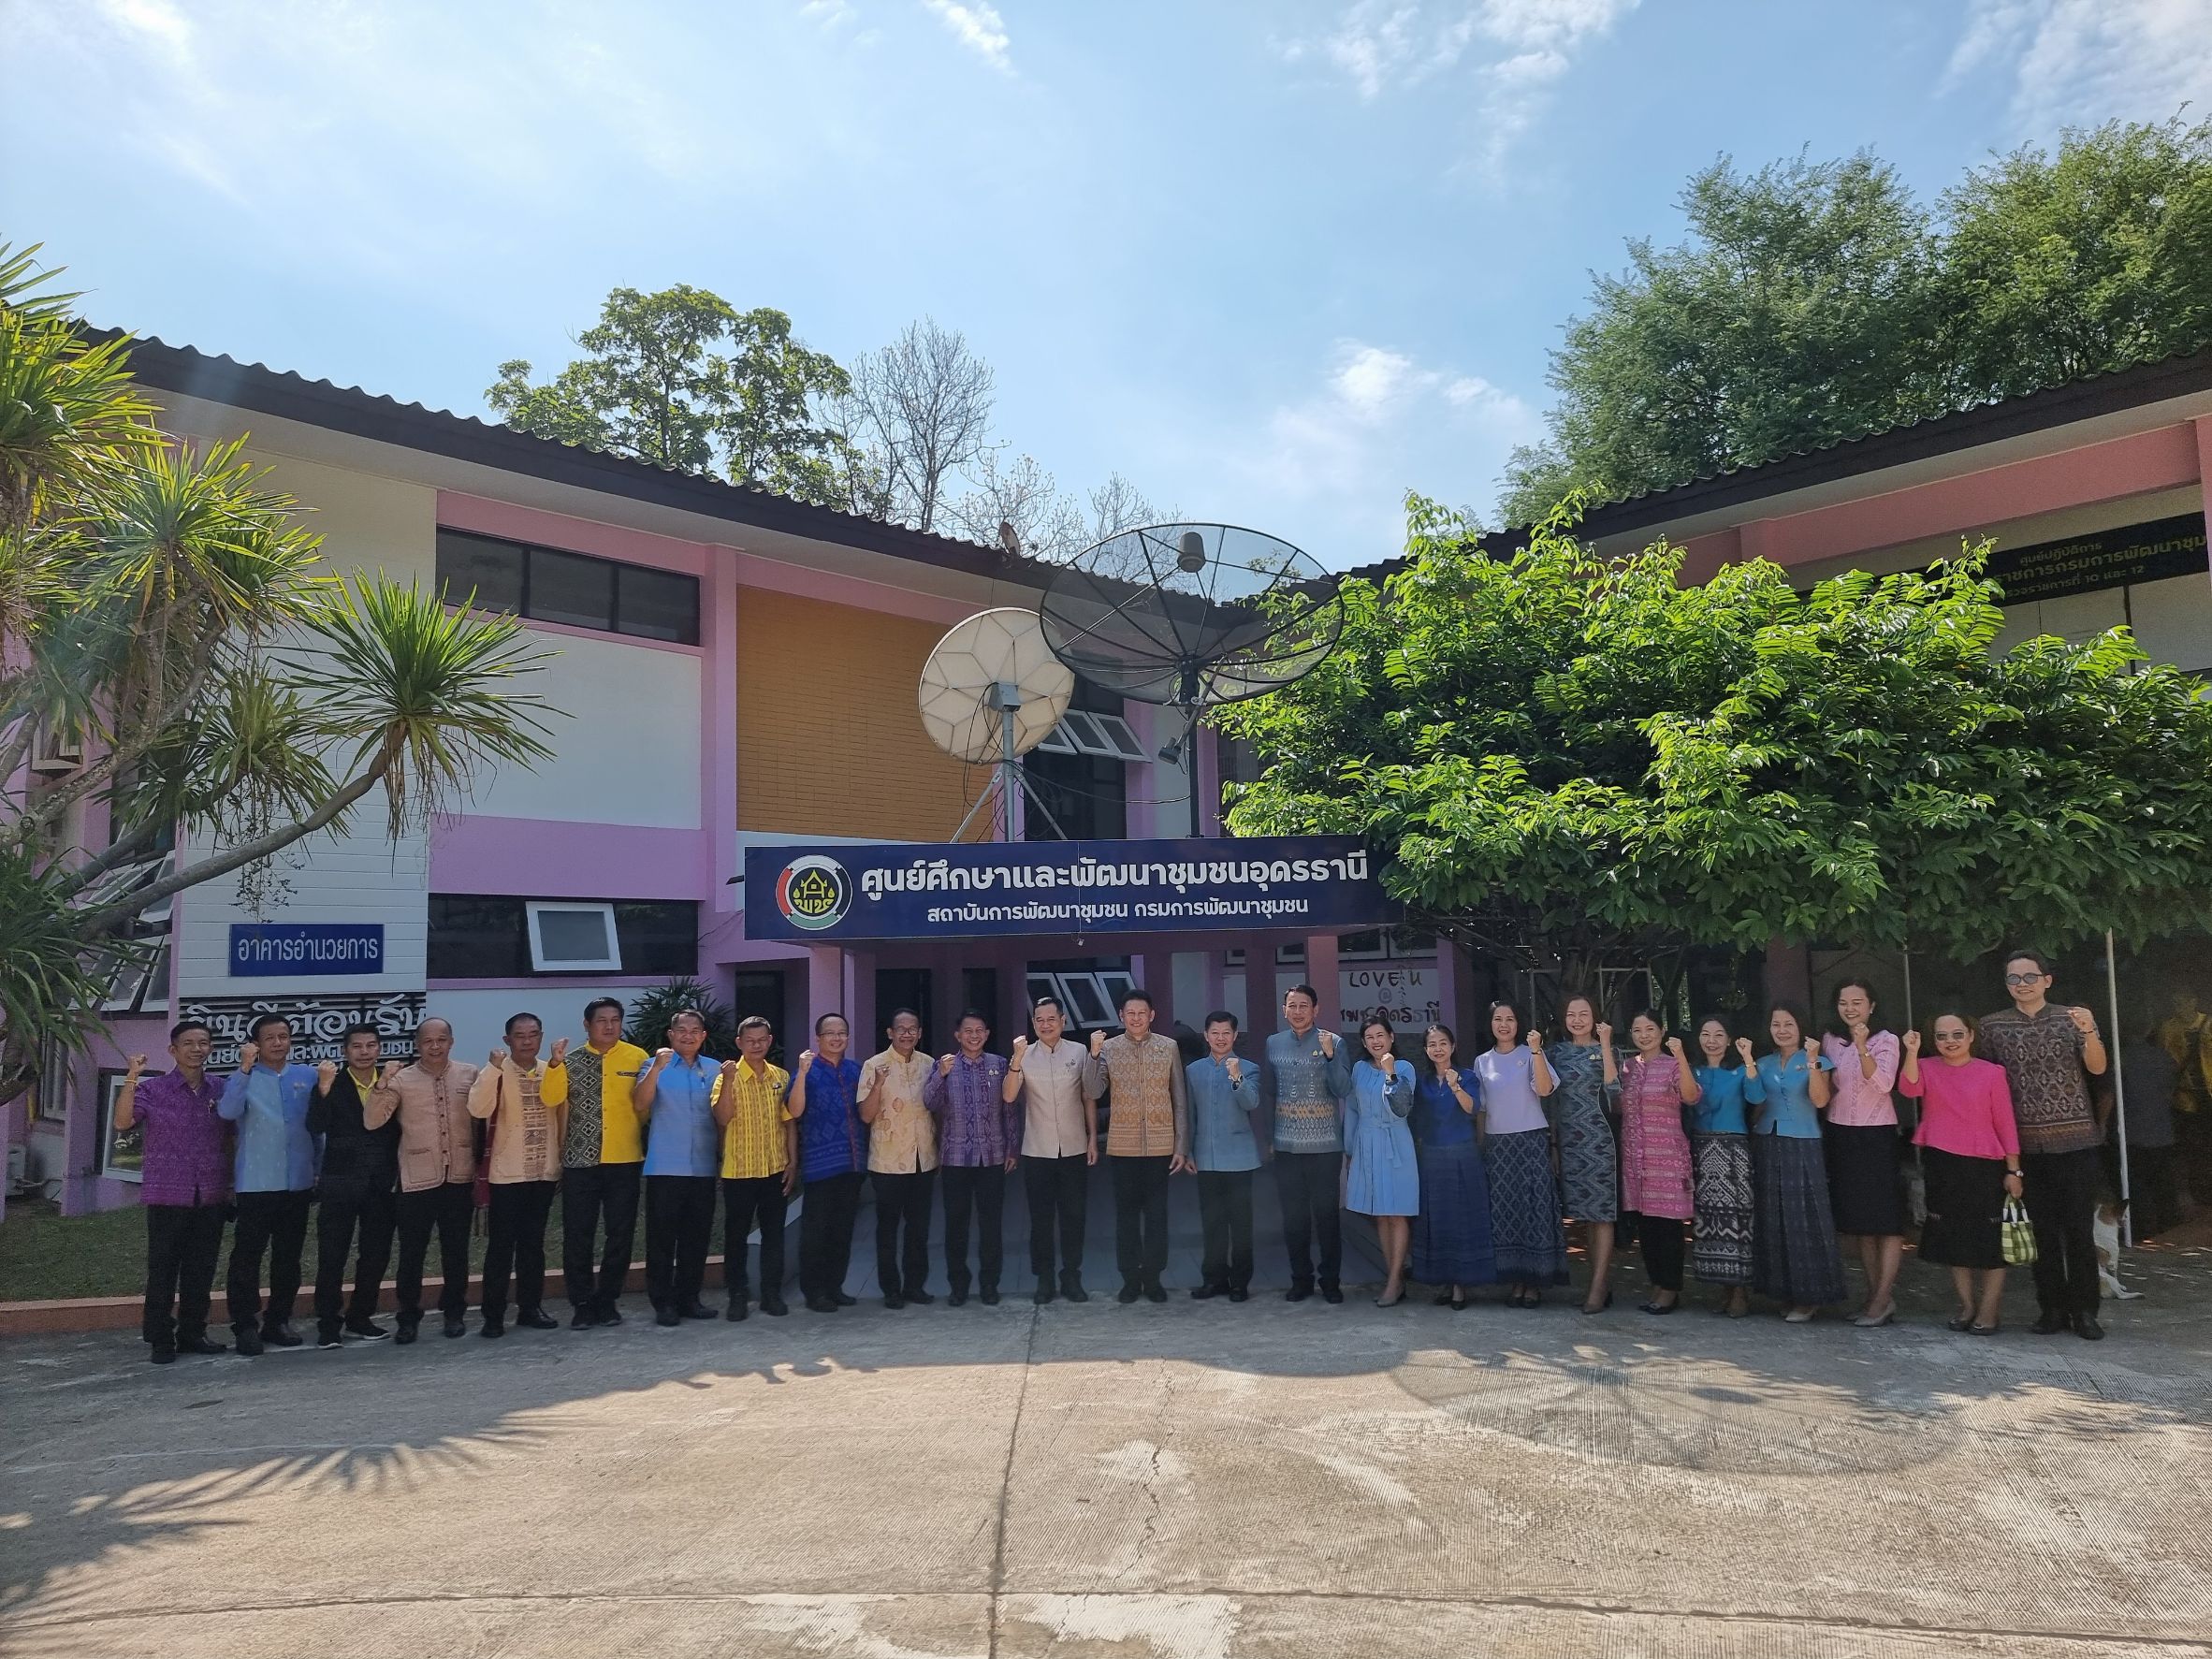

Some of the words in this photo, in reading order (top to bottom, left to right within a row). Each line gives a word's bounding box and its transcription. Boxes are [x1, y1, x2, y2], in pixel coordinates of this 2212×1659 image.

[1995, 536, 2206, 583] ราชการกรมการพัฒนาชุม
[2006, 573, 2081, 598] รวจราชการที่
[2085, 574, 2099, 584] 10
[2103, 569, 2127, 580] และ
[2130, 564, 2146, 575] 12
[861, 849, 1368, 901] ศูนย์ศึกษาและพัฒนาชุมชนอุดรธานี
[927, 900, 1128, 924] สถาบันการพัฒนาชุมชน
[1134, 896, 1309, 920] กรมการพัฒนาชุมชน
[238, 931, 379, 962] อาคารอำนวยการ
[1349, 971, 1400, 988] LOVE
